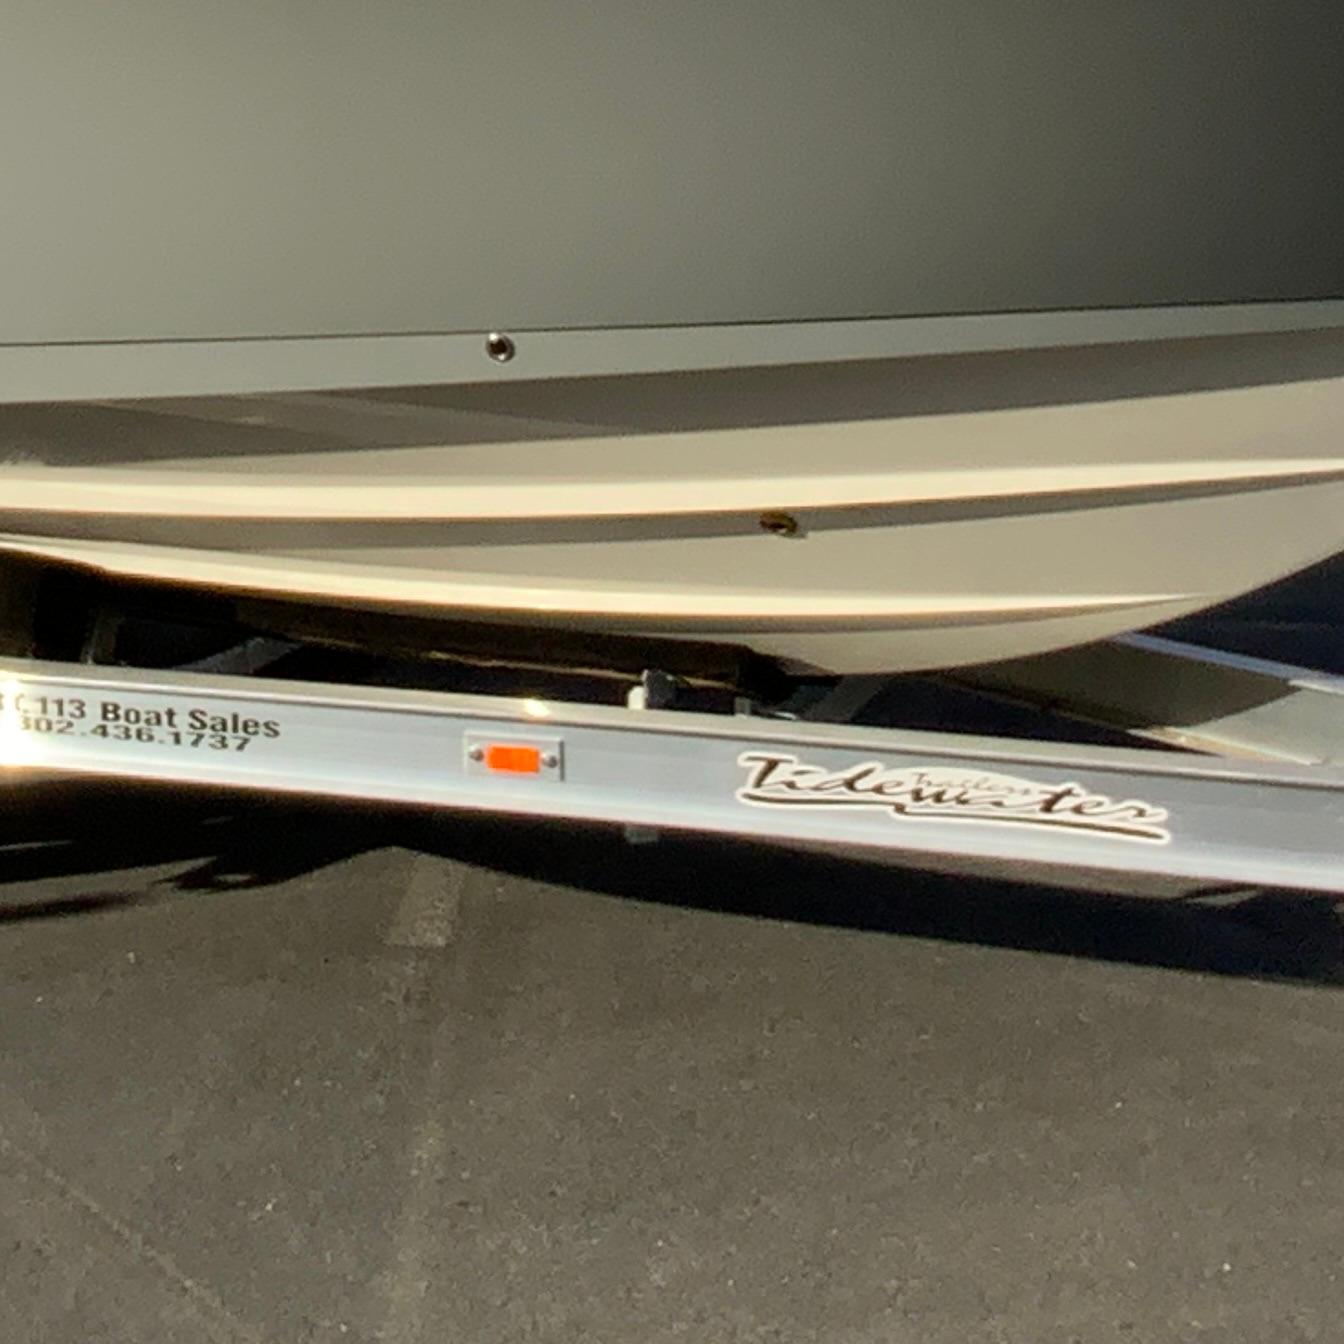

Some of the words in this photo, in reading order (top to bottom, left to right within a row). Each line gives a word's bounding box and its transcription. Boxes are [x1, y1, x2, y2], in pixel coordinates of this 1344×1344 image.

[101, 701, 178, 729] Boat
[188, 709, 281, 738] Sales
[745, 755, 1156, 821] Tidewater
